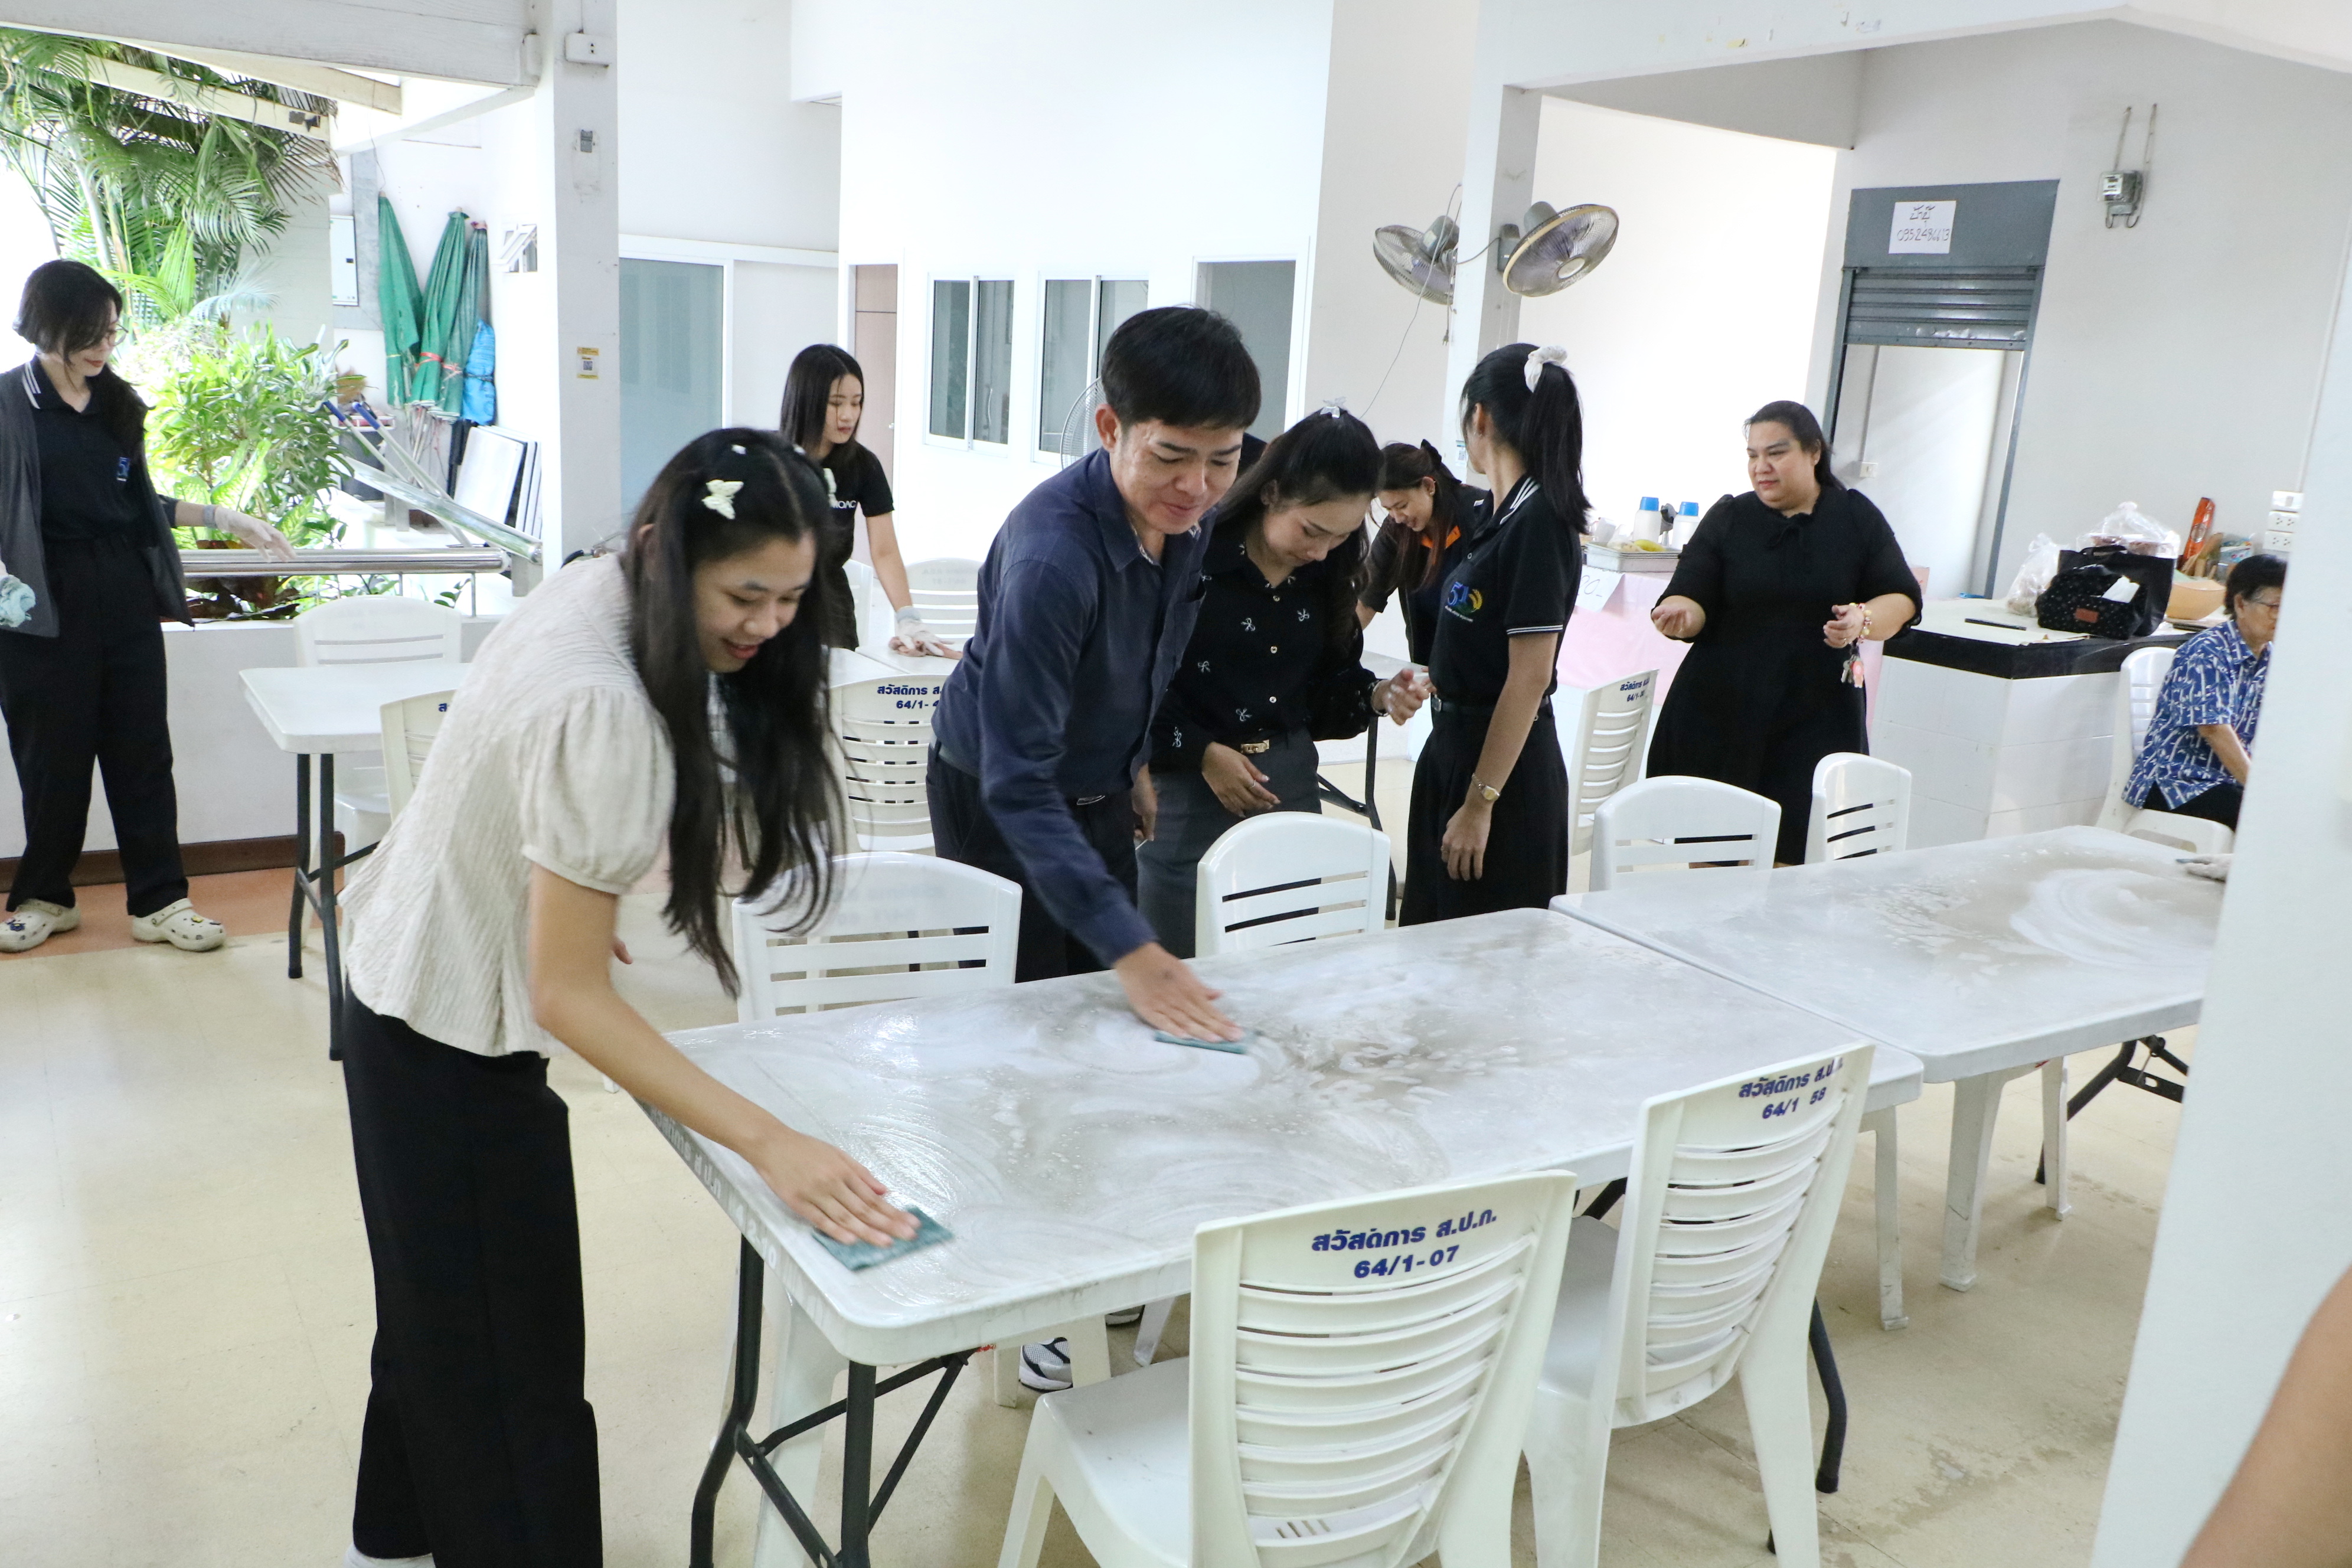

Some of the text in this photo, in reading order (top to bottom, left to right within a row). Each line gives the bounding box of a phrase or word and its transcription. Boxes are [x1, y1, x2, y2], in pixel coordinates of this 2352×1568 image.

[877, 684, 928, 695] สวัสดิการ
[1739, 1073, 1811, 1097] สวัสดิการ
[1311, 1208, 1497, 1251] สวัสดิการ ส.ป.ก.
[1354, 1244, 1459, 1279] 64/1-07
